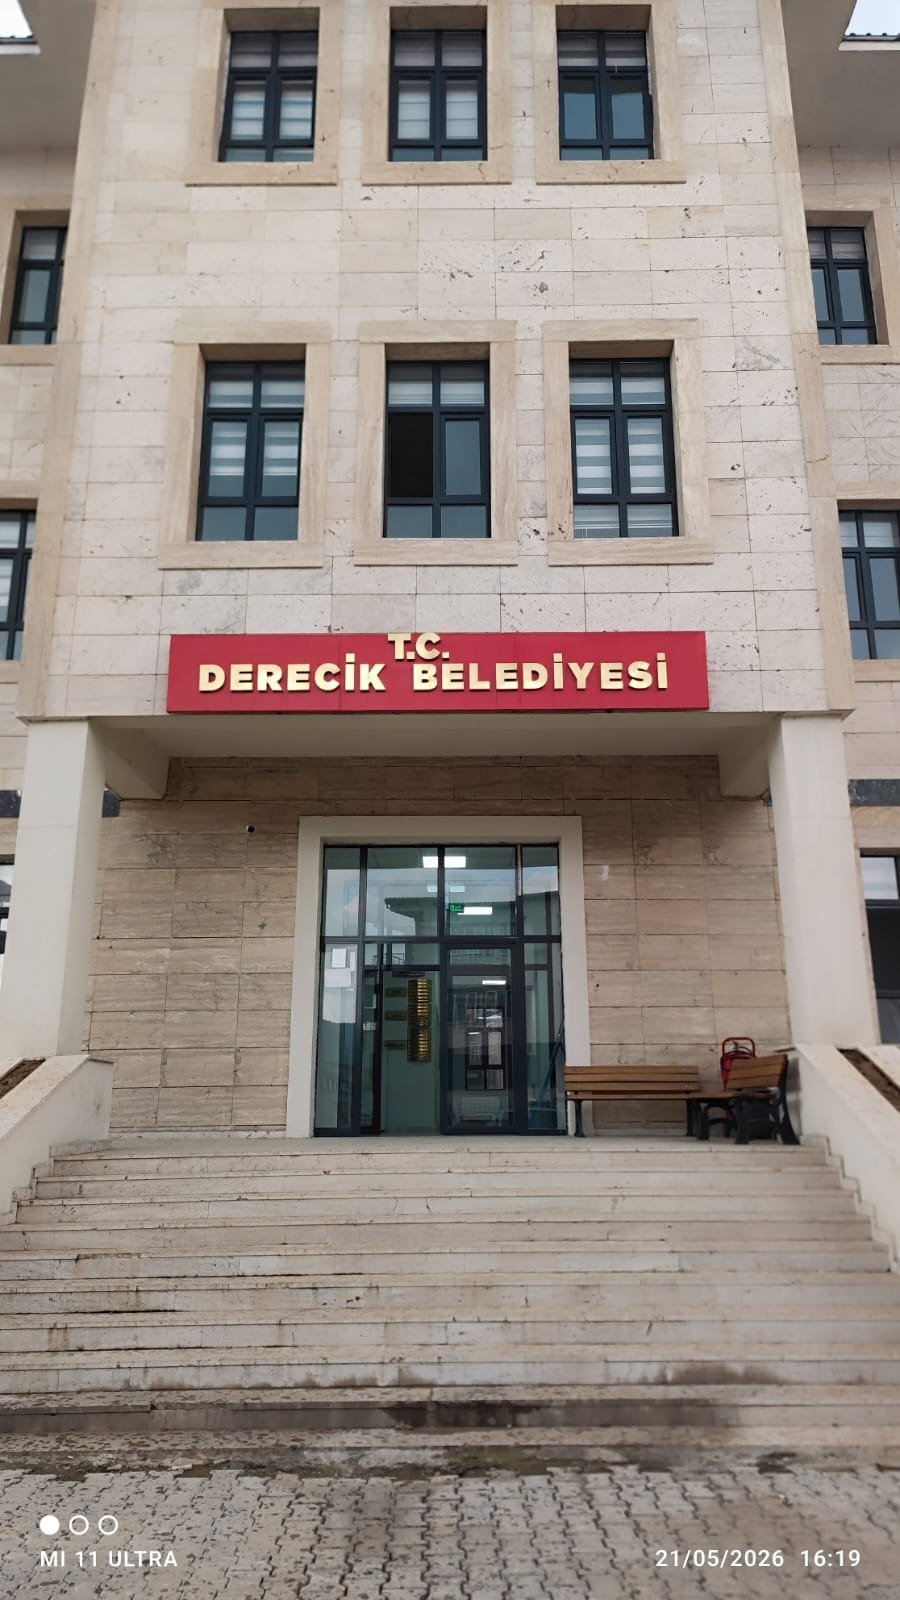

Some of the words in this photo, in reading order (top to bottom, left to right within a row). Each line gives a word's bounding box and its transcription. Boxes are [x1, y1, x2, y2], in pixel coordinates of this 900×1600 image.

[388, 632, 450, 660] T.C.
[199, 653, 386, 692] DERECİK
[413, 652, 667, 691] BELEDİYESİ
